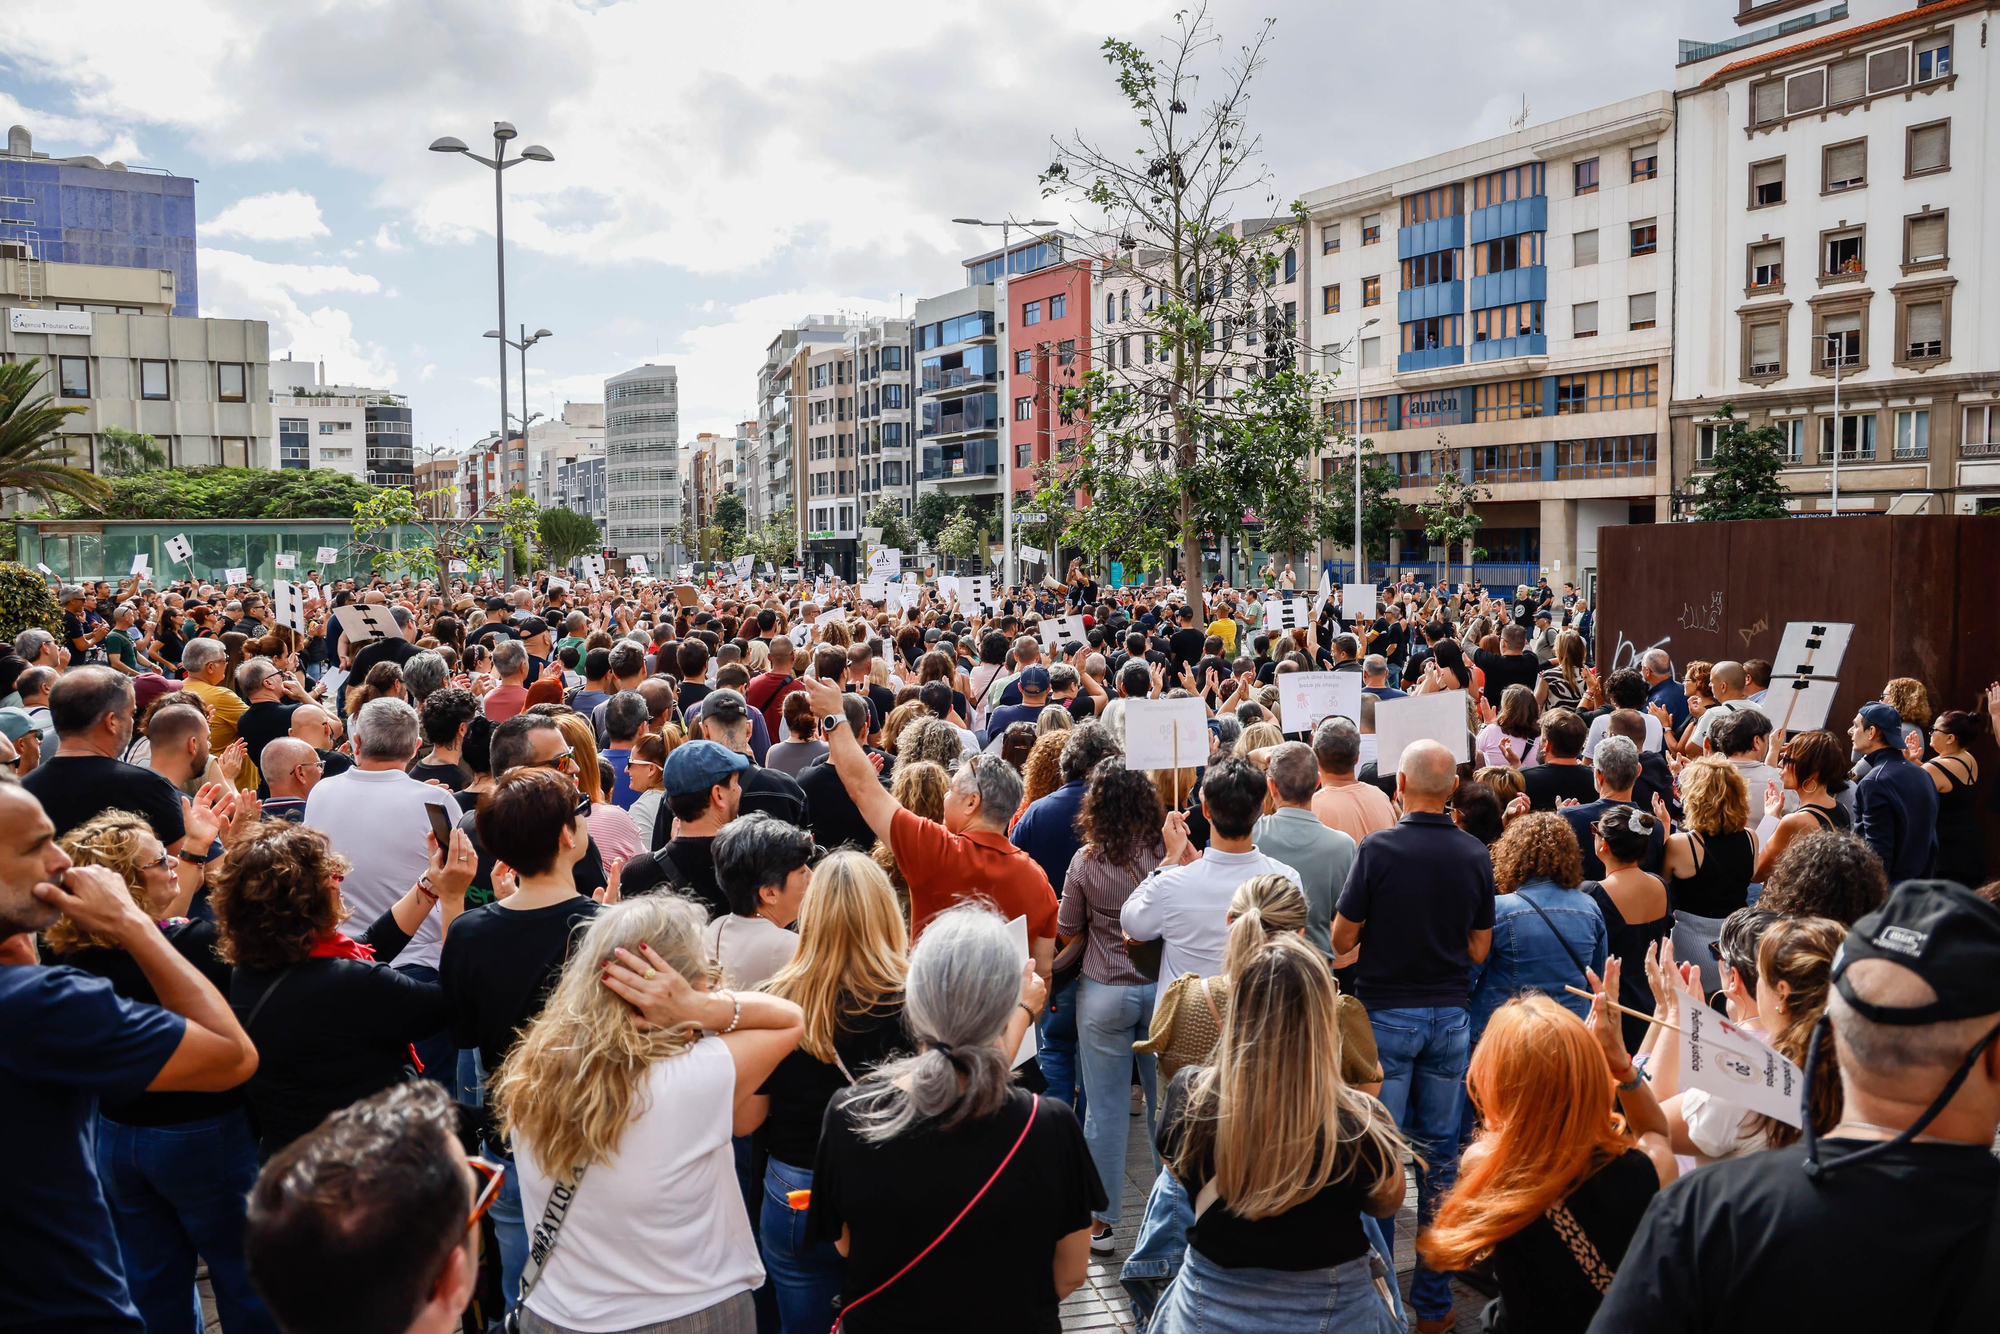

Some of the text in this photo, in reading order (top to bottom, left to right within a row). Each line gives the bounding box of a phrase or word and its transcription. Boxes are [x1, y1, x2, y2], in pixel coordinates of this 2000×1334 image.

[42, 322, 68, 330] Tributaria
[1411, 398, 1458, 414] auren
[1689, 1007, 1703, 1072] Pedimos justicia
[1735, 1061, 1750, 1077] 30
